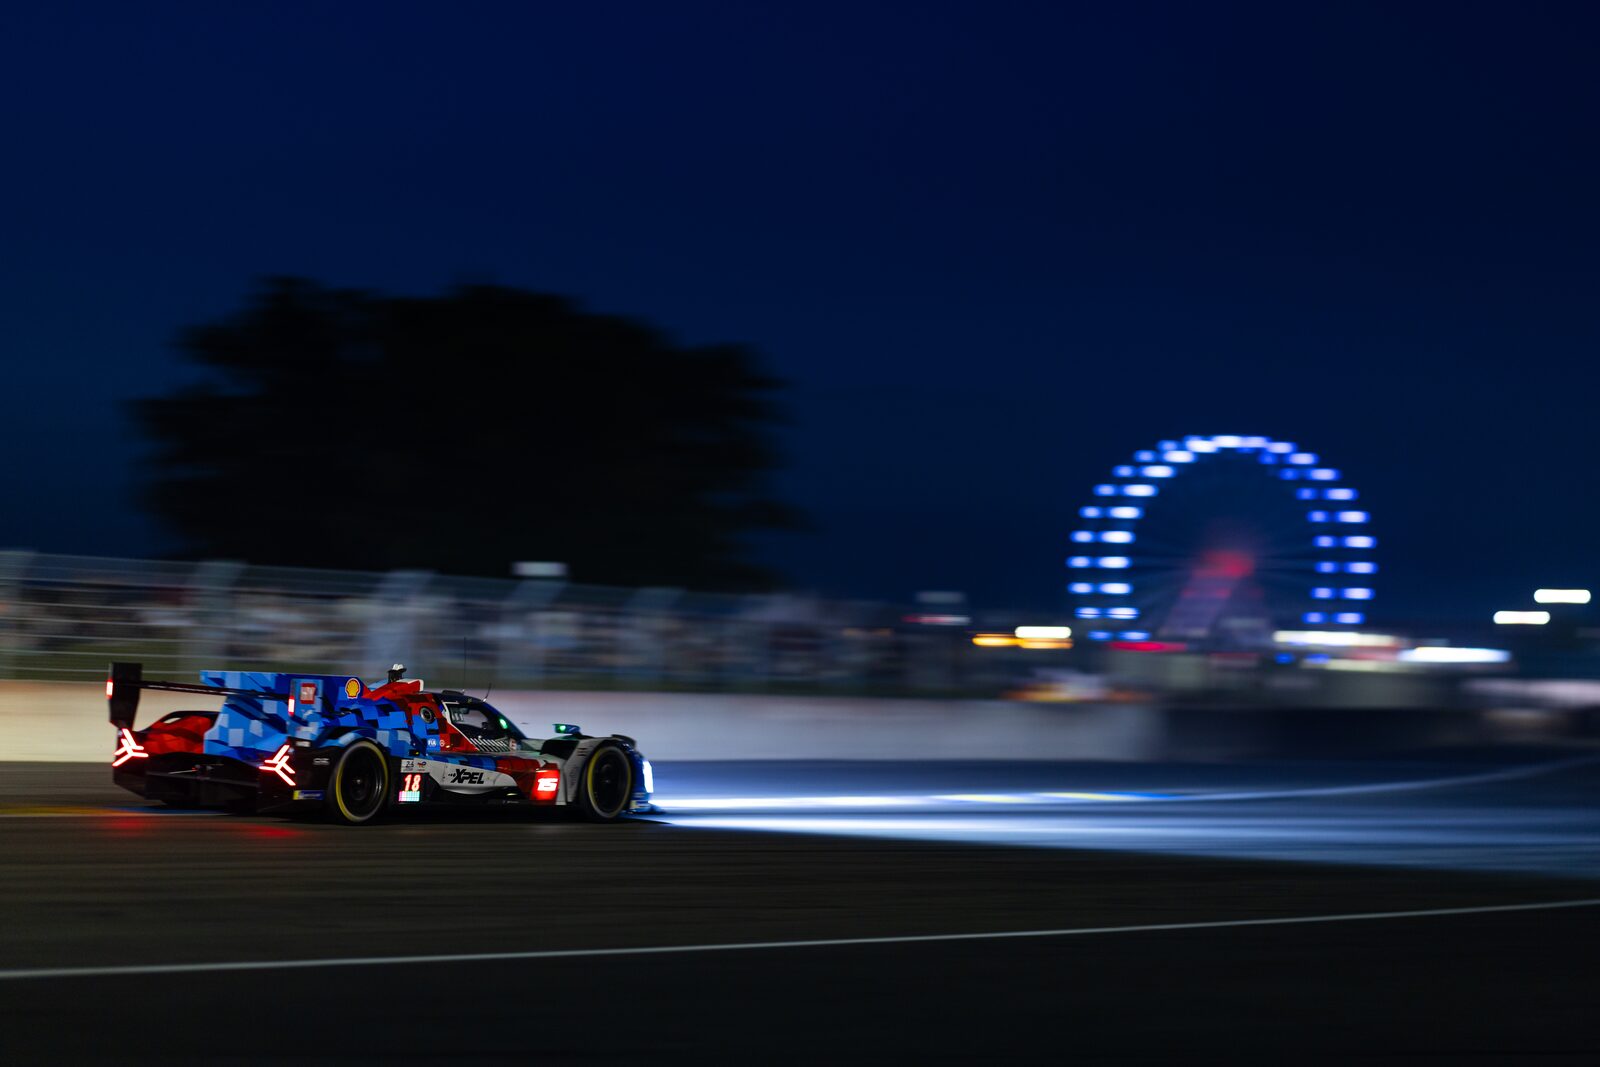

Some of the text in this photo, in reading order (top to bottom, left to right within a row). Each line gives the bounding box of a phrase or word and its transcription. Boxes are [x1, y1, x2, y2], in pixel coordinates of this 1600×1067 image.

[404, 774, 421, 792] 18
[451, 769, 484, 785] XPEL
[537, 778, 558, 791] 15
